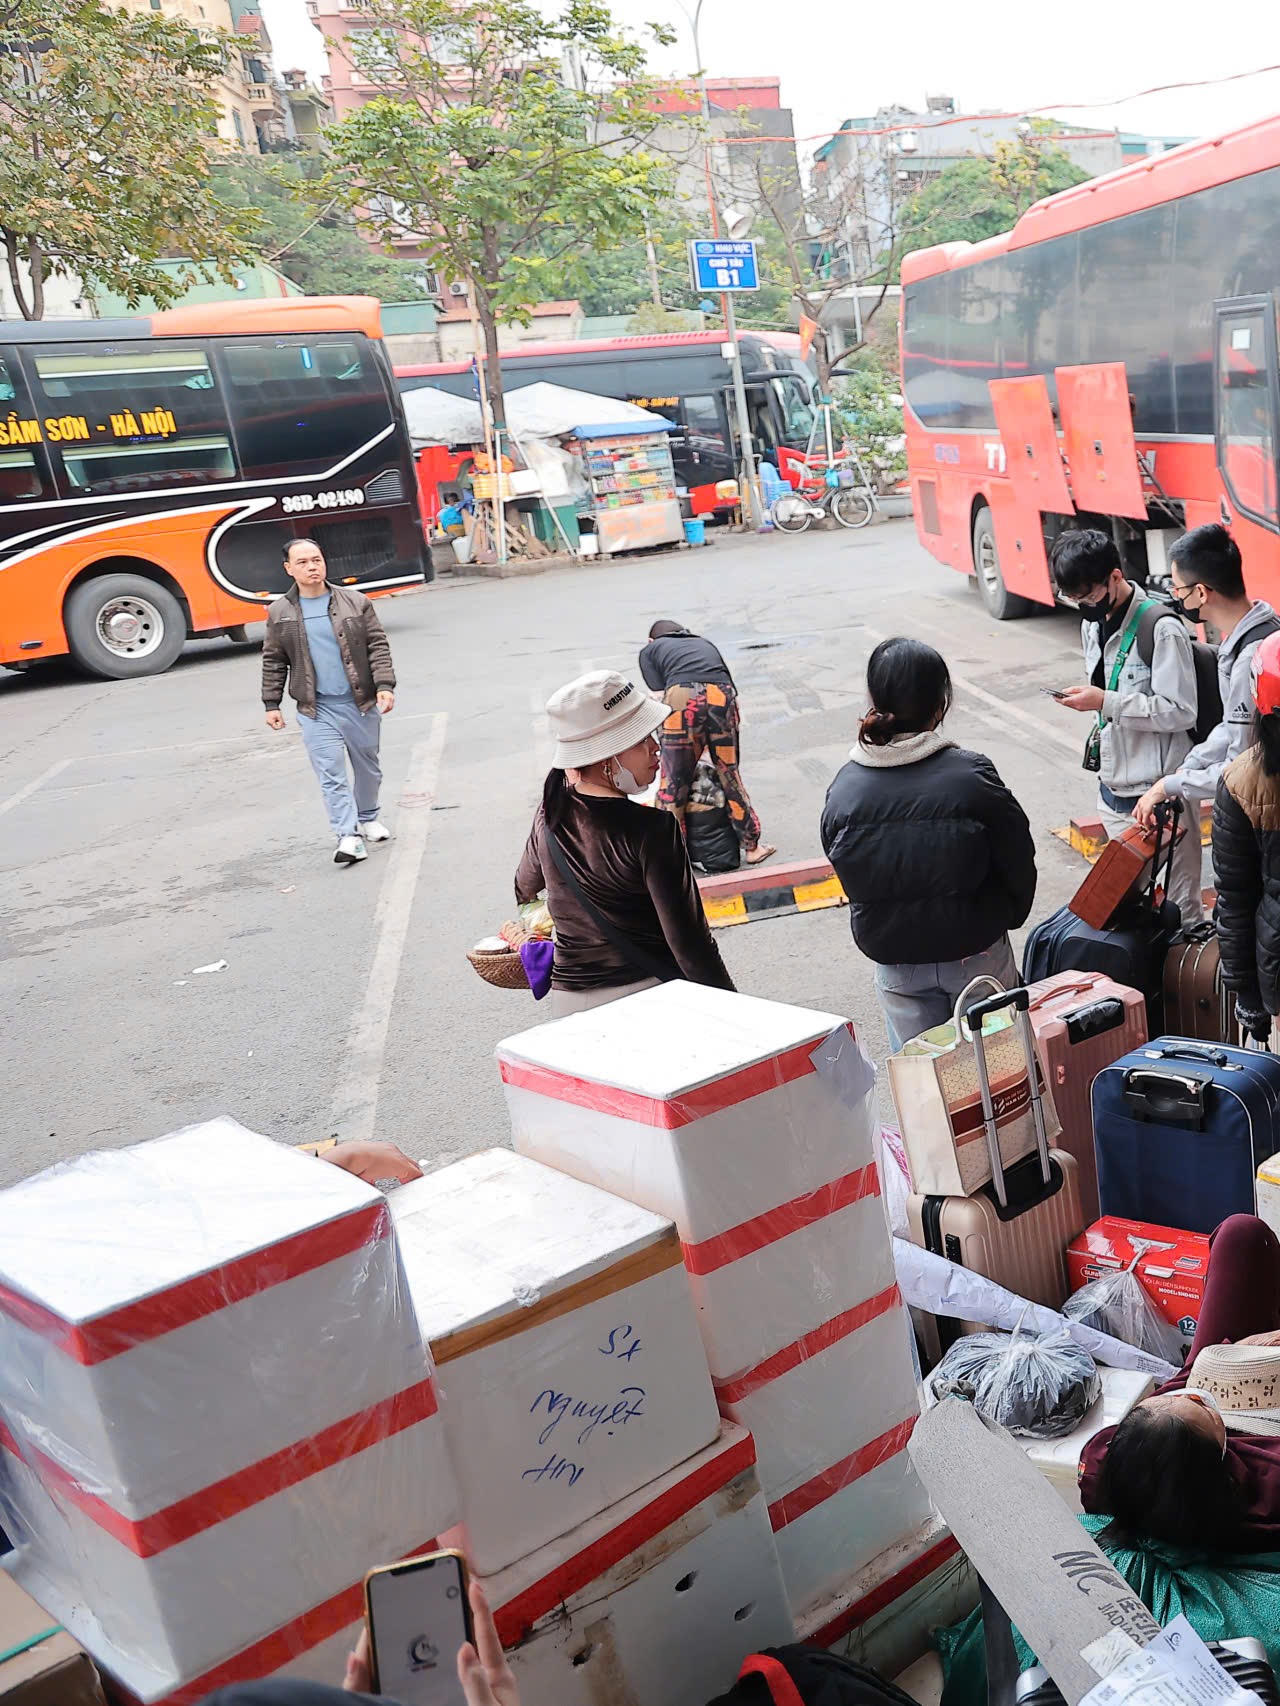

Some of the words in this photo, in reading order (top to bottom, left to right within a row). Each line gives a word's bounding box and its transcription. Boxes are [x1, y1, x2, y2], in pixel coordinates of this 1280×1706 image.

[716, 269, 740, 286] B1
[0, 411, 43, 446] SẦM
[44, 415, 91, 442] SƠN
[109, 408, 141, 438] HÀ
[139, 406, 178, 438] NỘI
[1182, 1320, 1195, 1330] 12
[530, 1387, 646, 1445] Nguyệt
